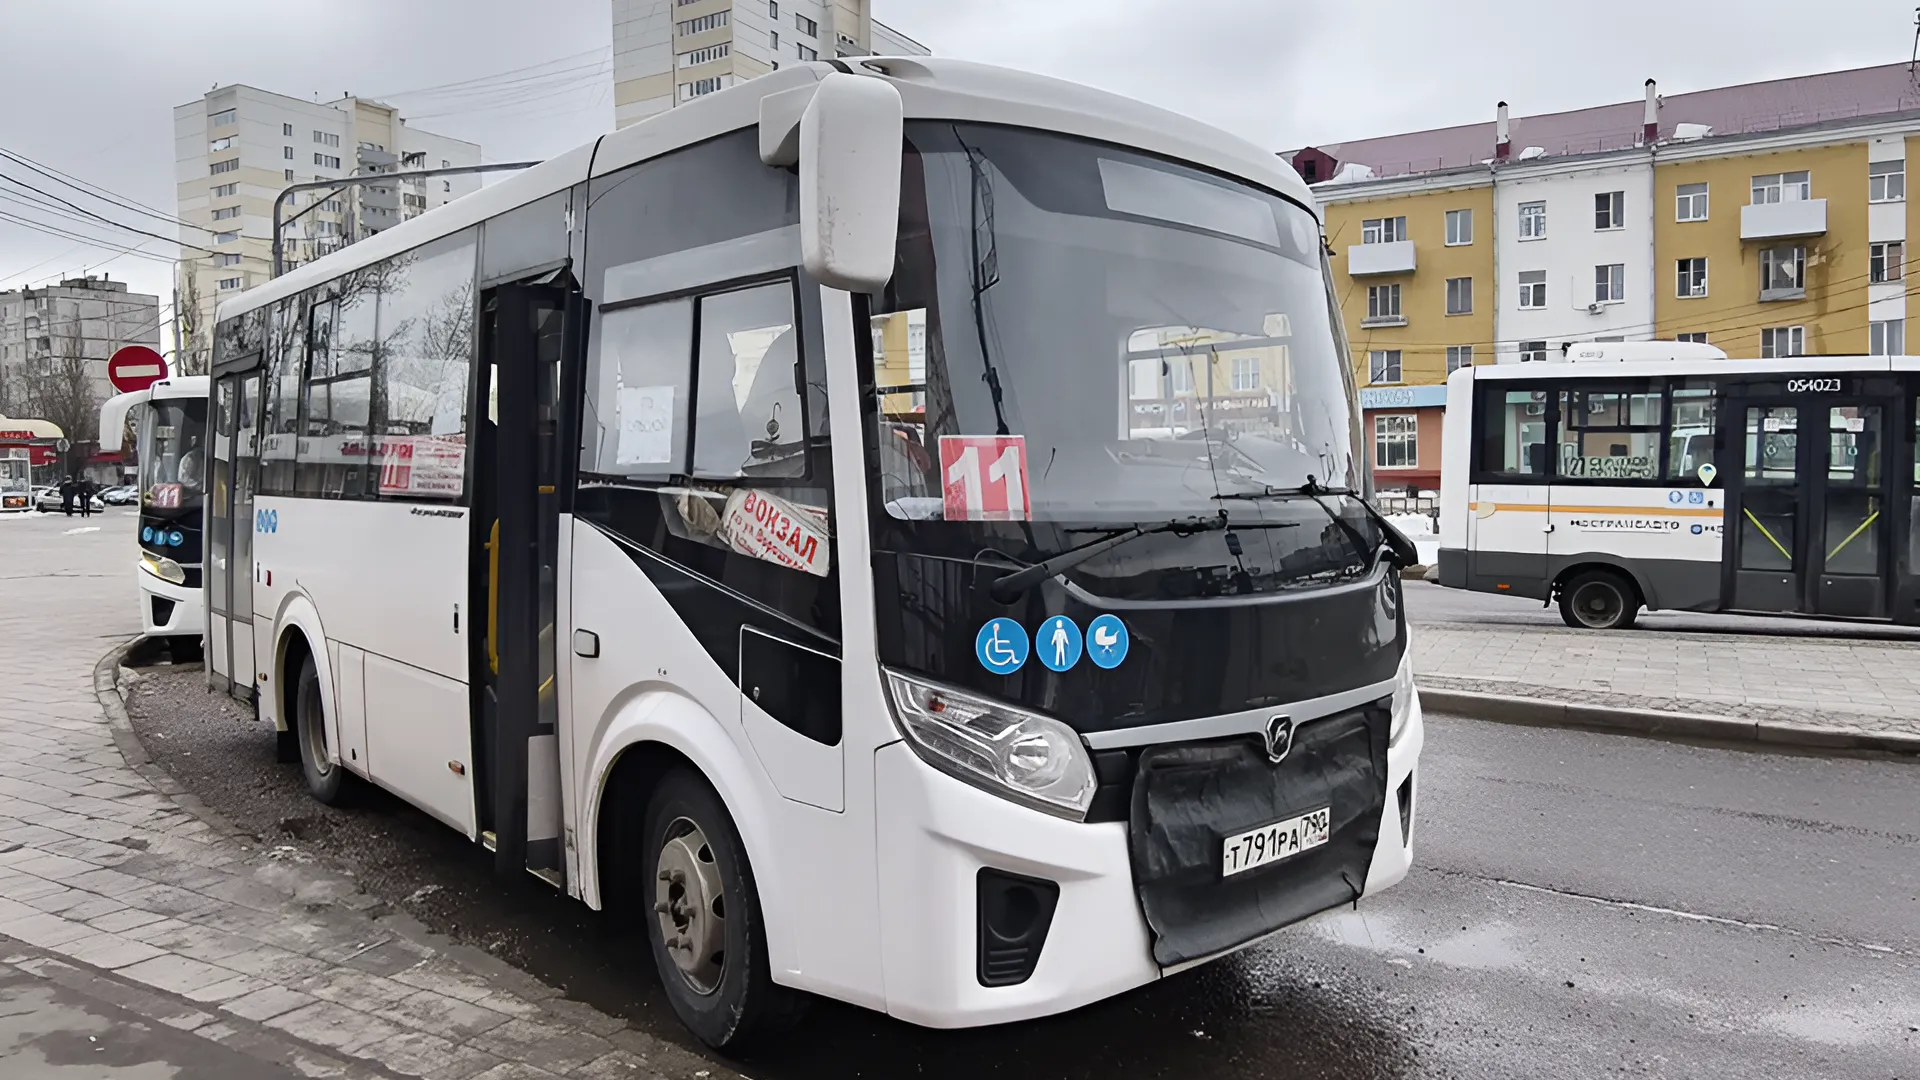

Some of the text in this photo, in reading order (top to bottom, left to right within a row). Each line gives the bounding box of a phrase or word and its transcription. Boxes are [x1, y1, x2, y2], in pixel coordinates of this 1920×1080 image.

[159, 487, 180, 508] 11
[948, 446, 1025, 521] 11
[744, 491, 818, 565] ВОКЗАЛ
